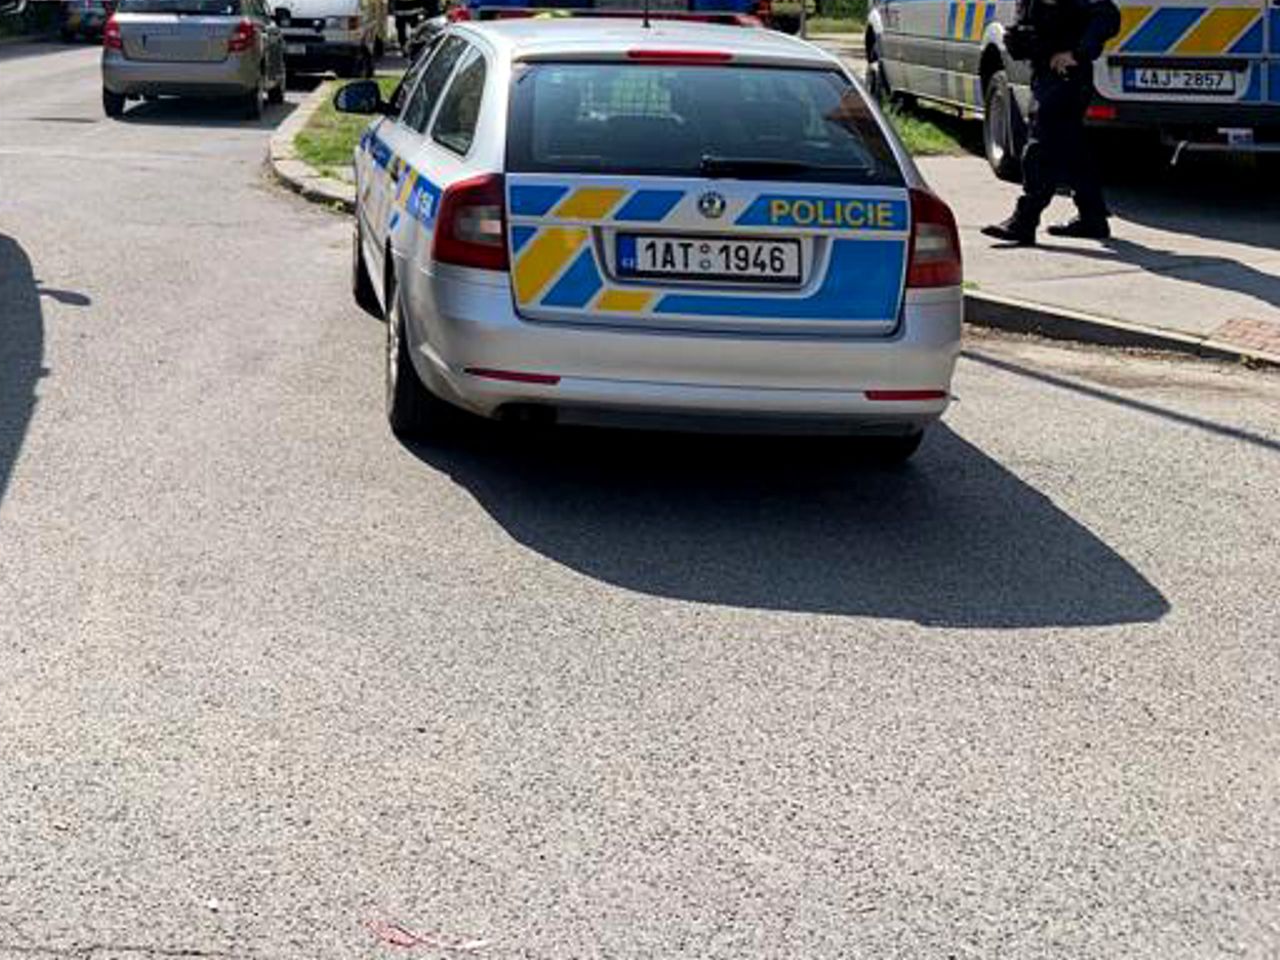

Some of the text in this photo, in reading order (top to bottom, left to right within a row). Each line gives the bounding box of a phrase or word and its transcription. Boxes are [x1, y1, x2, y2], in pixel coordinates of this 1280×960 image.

[1183, 71, 1224, 87] 2857
[768, 198, 895, 227] POLICIE
[644, 240, 785, 273] 1AT 1946
